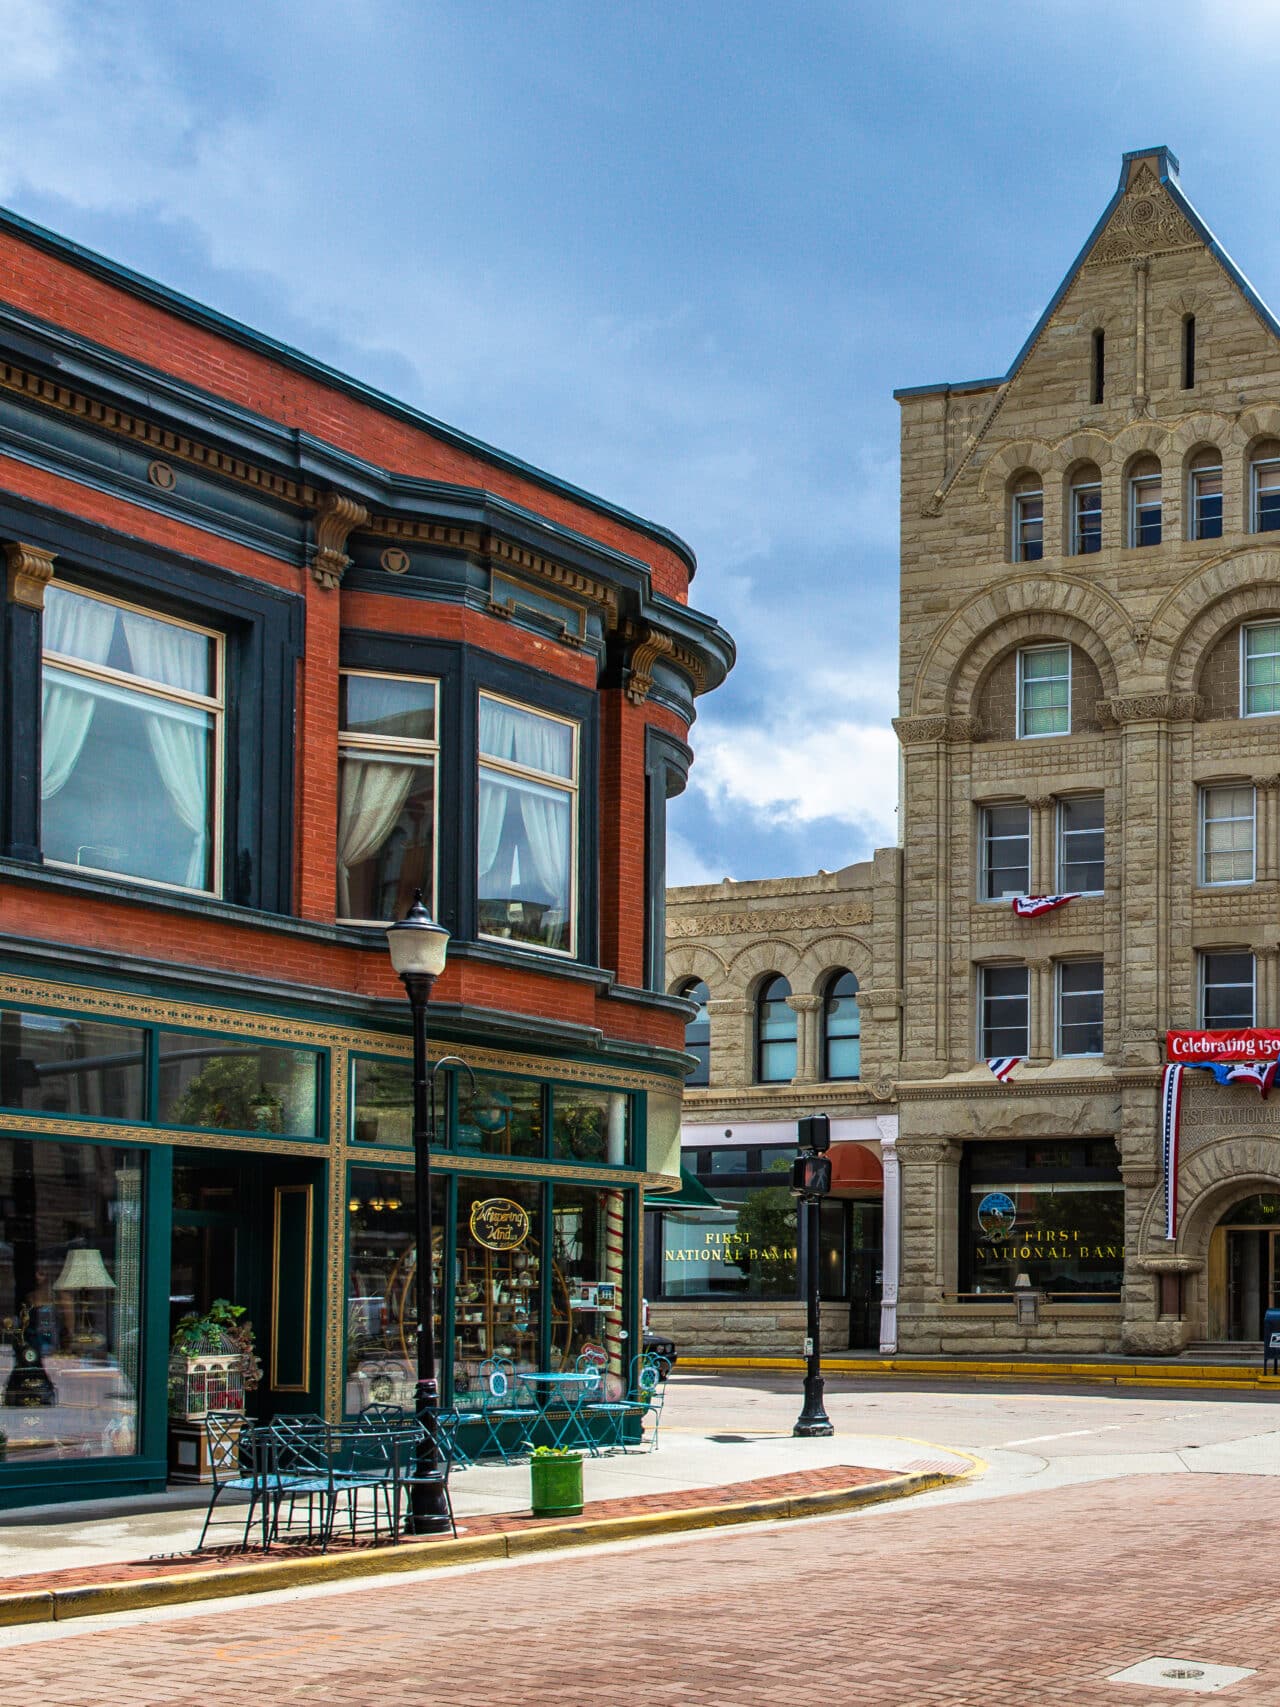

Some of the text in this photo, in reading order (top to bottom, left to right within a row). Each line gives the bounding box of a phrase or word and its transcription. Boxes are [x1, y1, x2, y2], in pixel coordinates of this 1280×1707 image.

[1172, 1036, 1255, 1056] Celebrating
[1259, 1039, 1280, 1055] 150
[1182, 1109, 1205, 1126] RST
[1218, 1107, 1280, 1125] NATIONAL
[705, 1233, 751, 1245] FIRST
[1025, 1230, 1081, 1242] FIRST
[665, 1248, 792, 1261] NATIONAL BANK
[976, 1247, 1071, 1259] NATIONAL
